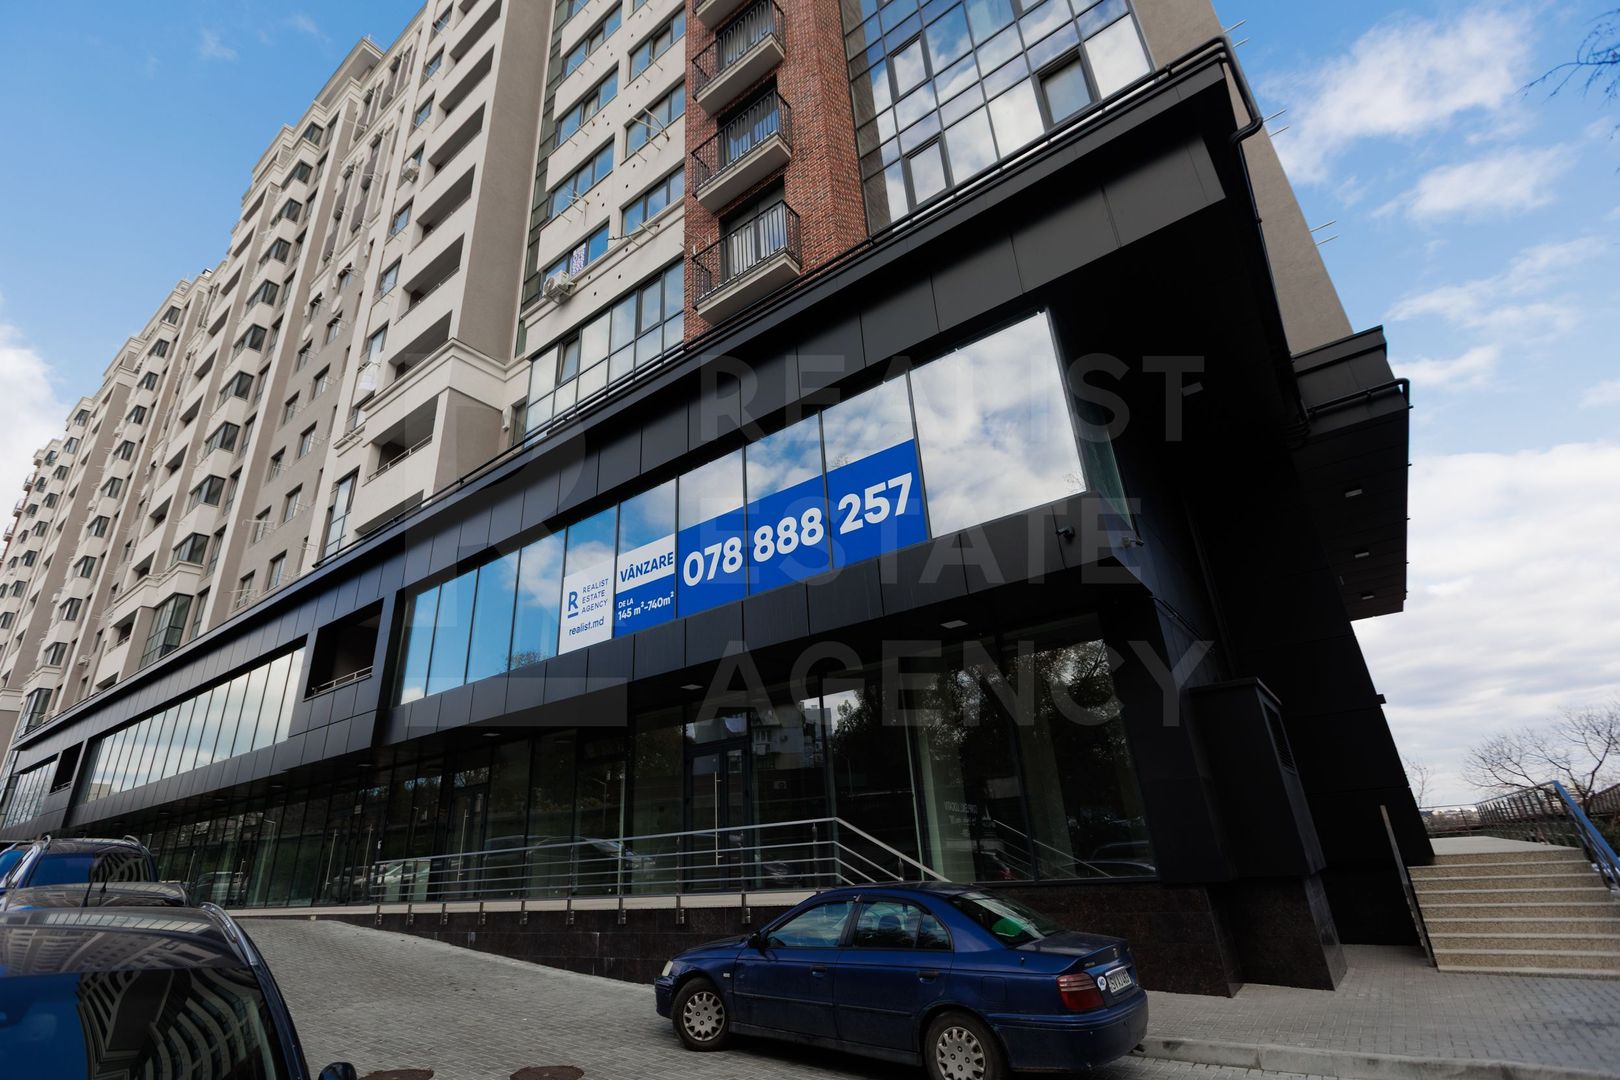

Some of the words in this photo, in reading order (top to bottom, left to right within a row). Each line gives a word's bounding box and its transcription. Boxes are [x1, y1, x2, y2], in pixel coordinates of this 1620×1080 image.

[682, 536, 743, 587] 078
[753, 507, 824, 563] 888
[837, 472, 913, 535] 257
[620, 551, 674, 583] VÂNZARE
[583, 578, 609, 594] REALIST
[582, 589, 606, 604] ESTATE
[618, 600, 626, 609] DE
[626, 598, 634, 606] LA
[581, 599, 608, 614] AGENCY
[618, 607, 632, 621] 145
[568, 616, 605, 636] realist.md
